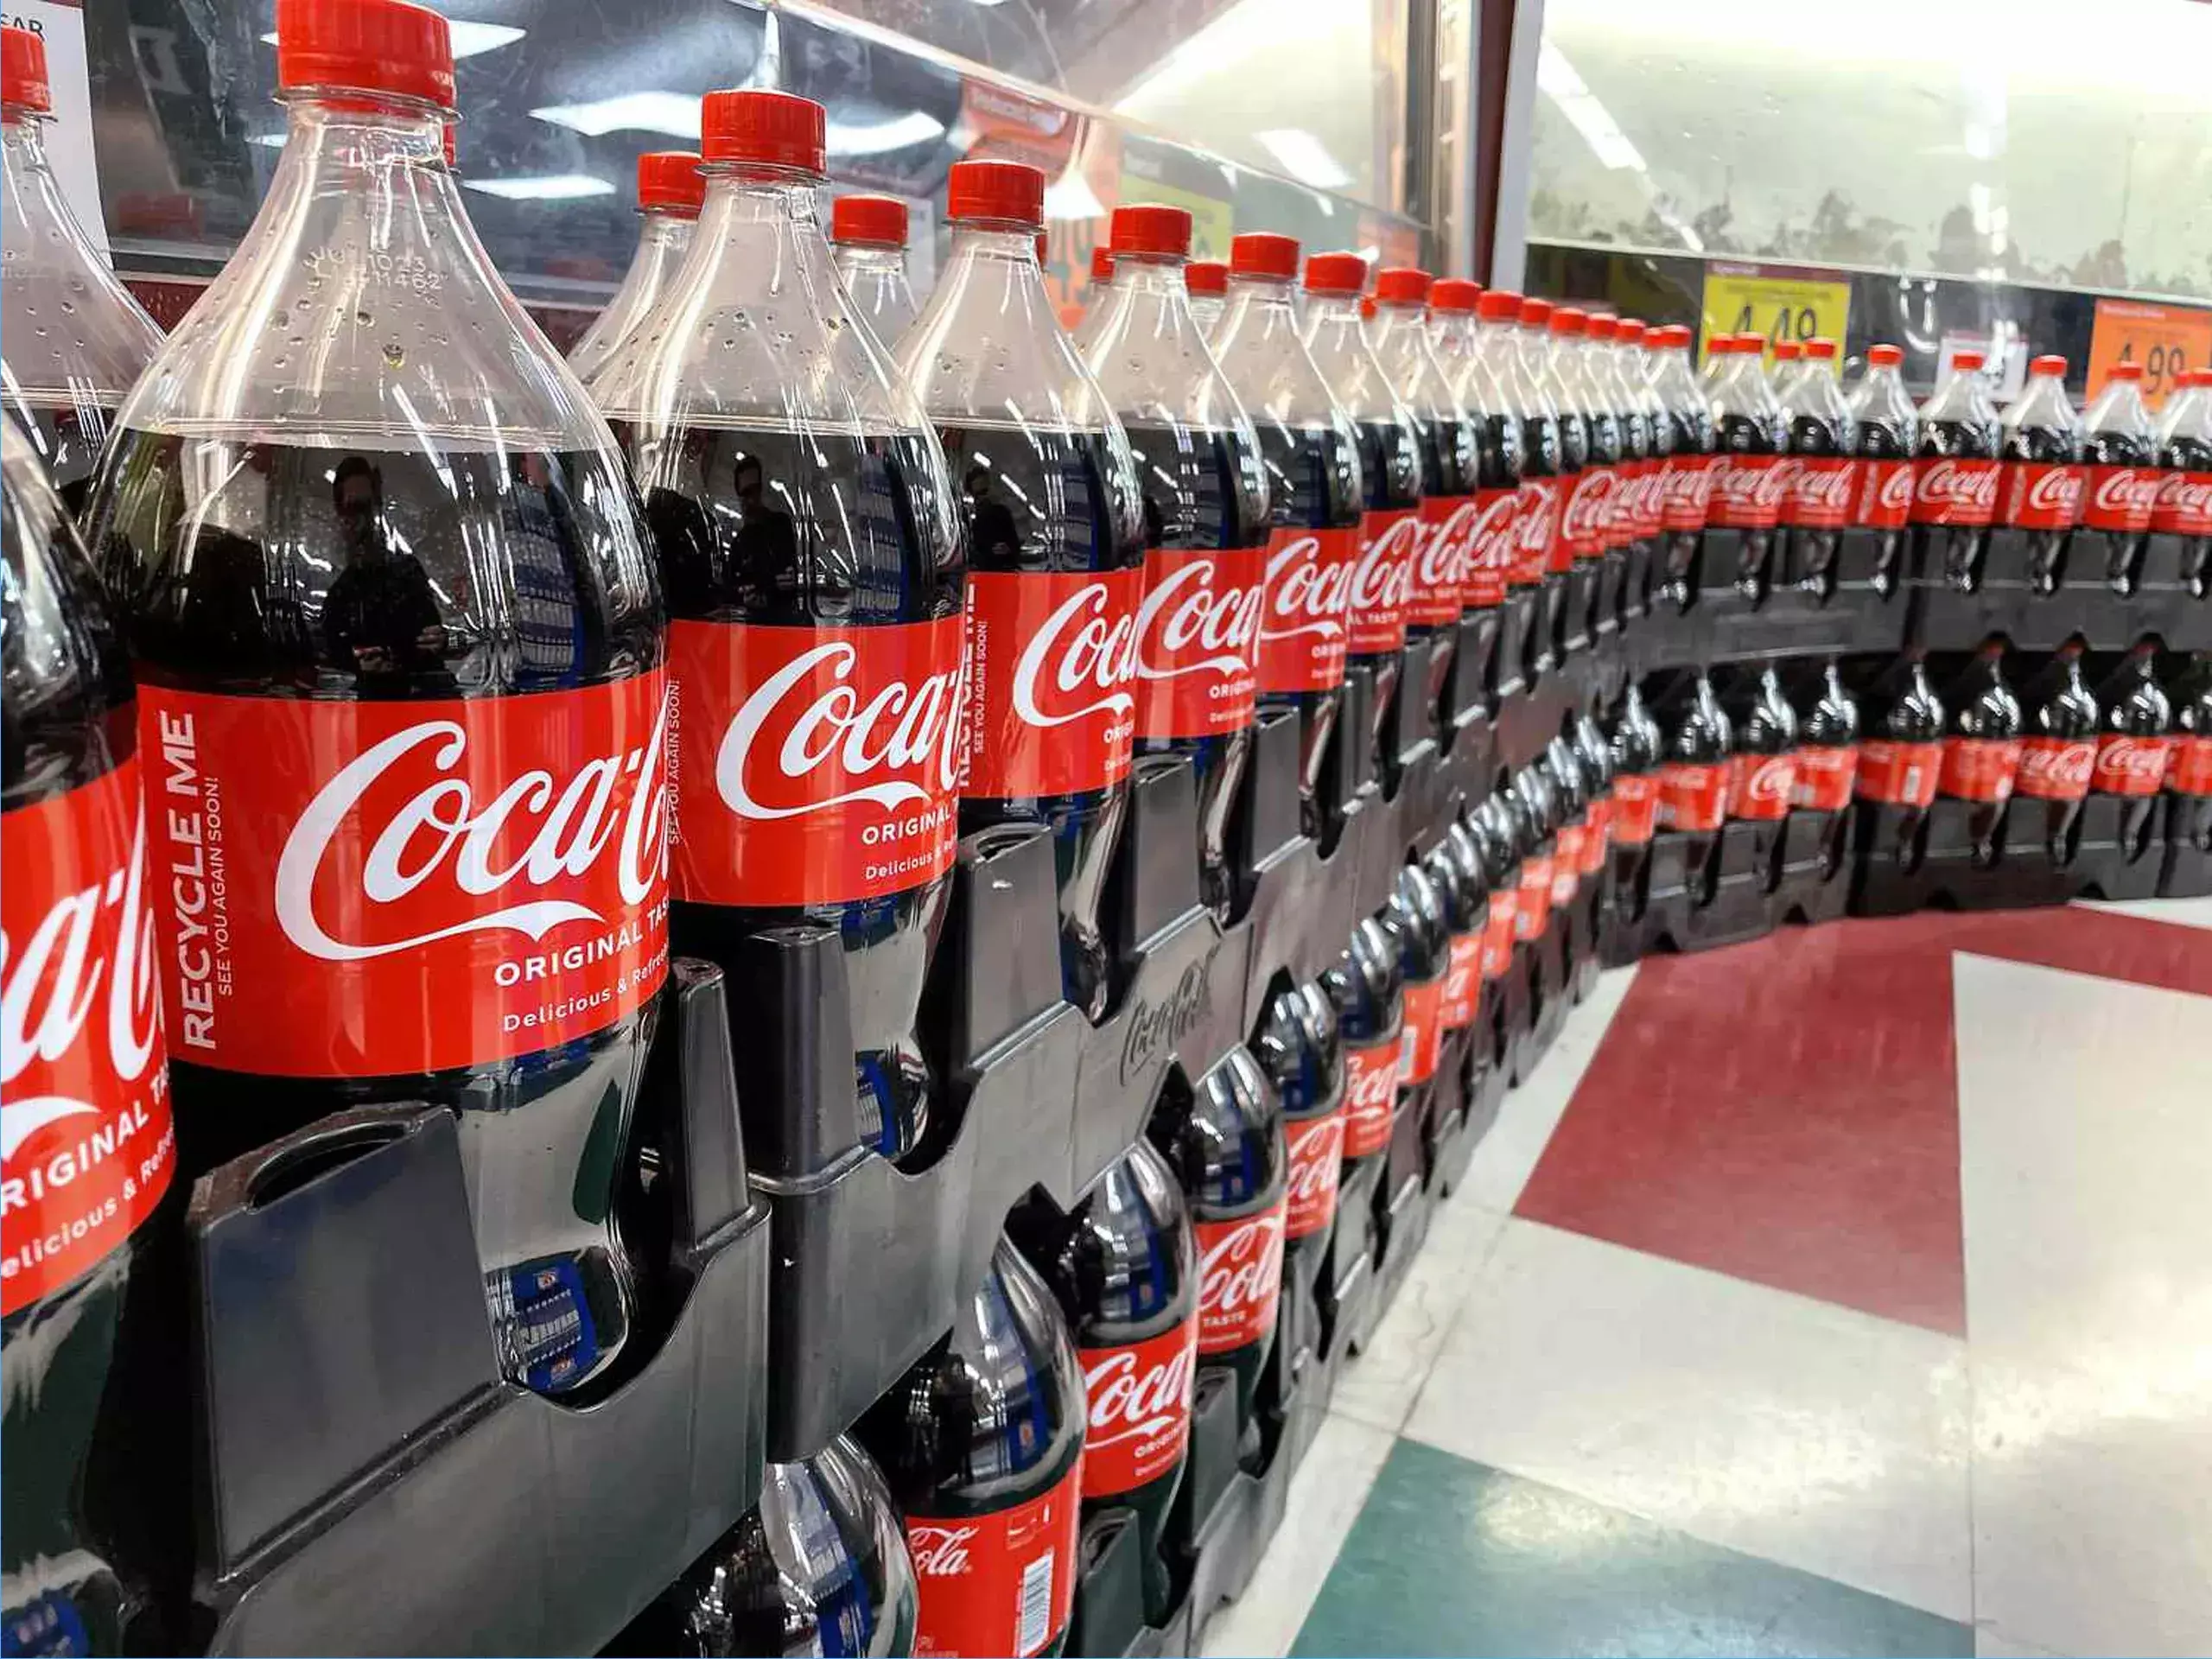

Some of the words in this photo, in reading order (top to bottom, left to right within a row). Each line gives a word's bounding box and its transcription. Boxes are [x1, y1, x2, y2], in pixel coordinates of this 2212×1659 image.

[666, 679, 681, 729] SOON!
[160, 709, 199, 796] ME
[667, 733, 680, 780] AGAIN
[203, 776, 223, 848] SOON!
[275, 681, 669, 960] Coca-C
[861, 804, 950, 845] ORIGINAL
[209, 848, 227, 908] AGAIN
[865, 851, 933, 880] Delicious
[168, 809, 217, 1050] RECYCLE
[214, 908, 231, 955] YOU
[493, 919, 643, 987] ORIGINAL
[646, 894, 670, 931] TAS
[218, 958, 233, 996] SEE
[504, 988, 611, 1032] Delicious
[617, 977, 628, 994] &
[0, 1099, 149, 1216] RIGINAL
[0, 1196, 118, 1279] elicious
[123, 1177, 137, 1201] &
